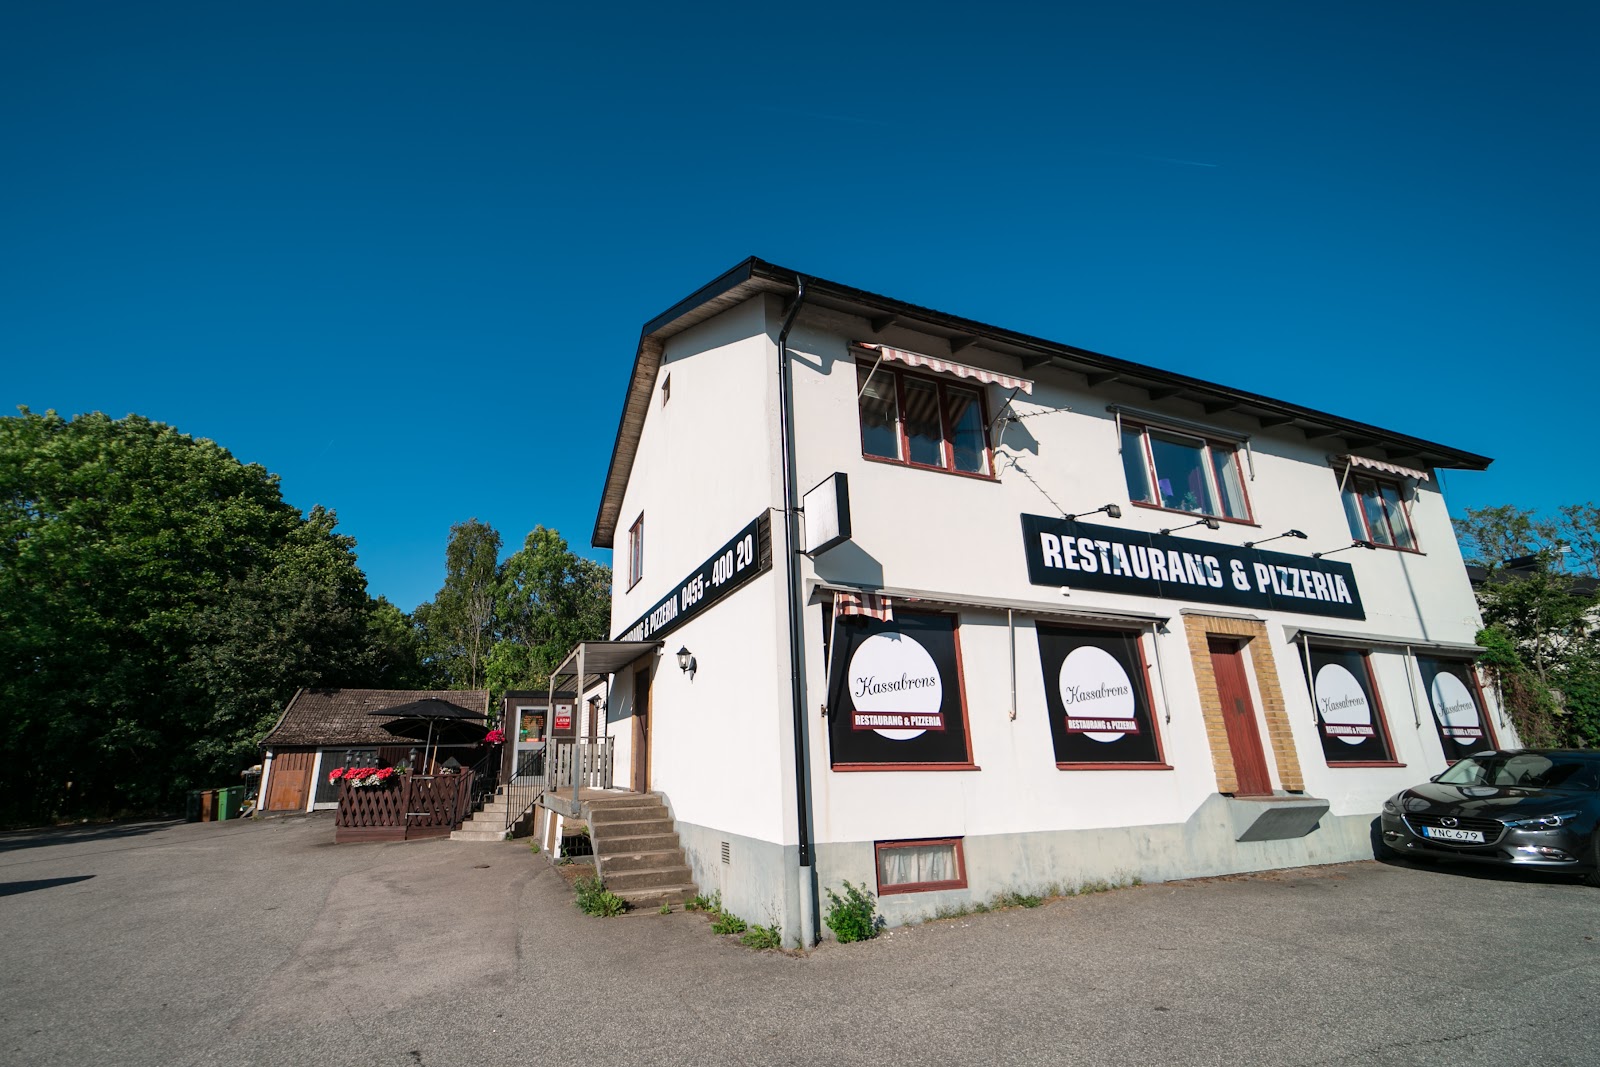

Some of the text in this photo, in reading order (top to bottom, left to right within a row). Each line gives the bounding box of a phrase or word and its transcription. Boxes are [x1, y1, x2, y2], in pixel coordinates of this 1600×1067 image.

[1039, 532, 1353, 604] RESTAURANG & PIZZERIA
[644, 617, 649, 638] &
[650, 594, 678, 634] PIZZERIA
[681, 573, 704, 611] 0455
[711, 549, 733, 588] 400
[736, 533, 753, 572] 20
[854, 672, 936, 698] Kassabrons
[1066, 682, 1129, 705] Kassabrons
[854, 715, 941, 726] RESTAURANG & PIZZERIA
[1068, 720, 1106, 729] RESTAURANG
[1111, 721, 1136, 730] PIZZERIA
[1431, 828, 1478, 840] YNC 679
